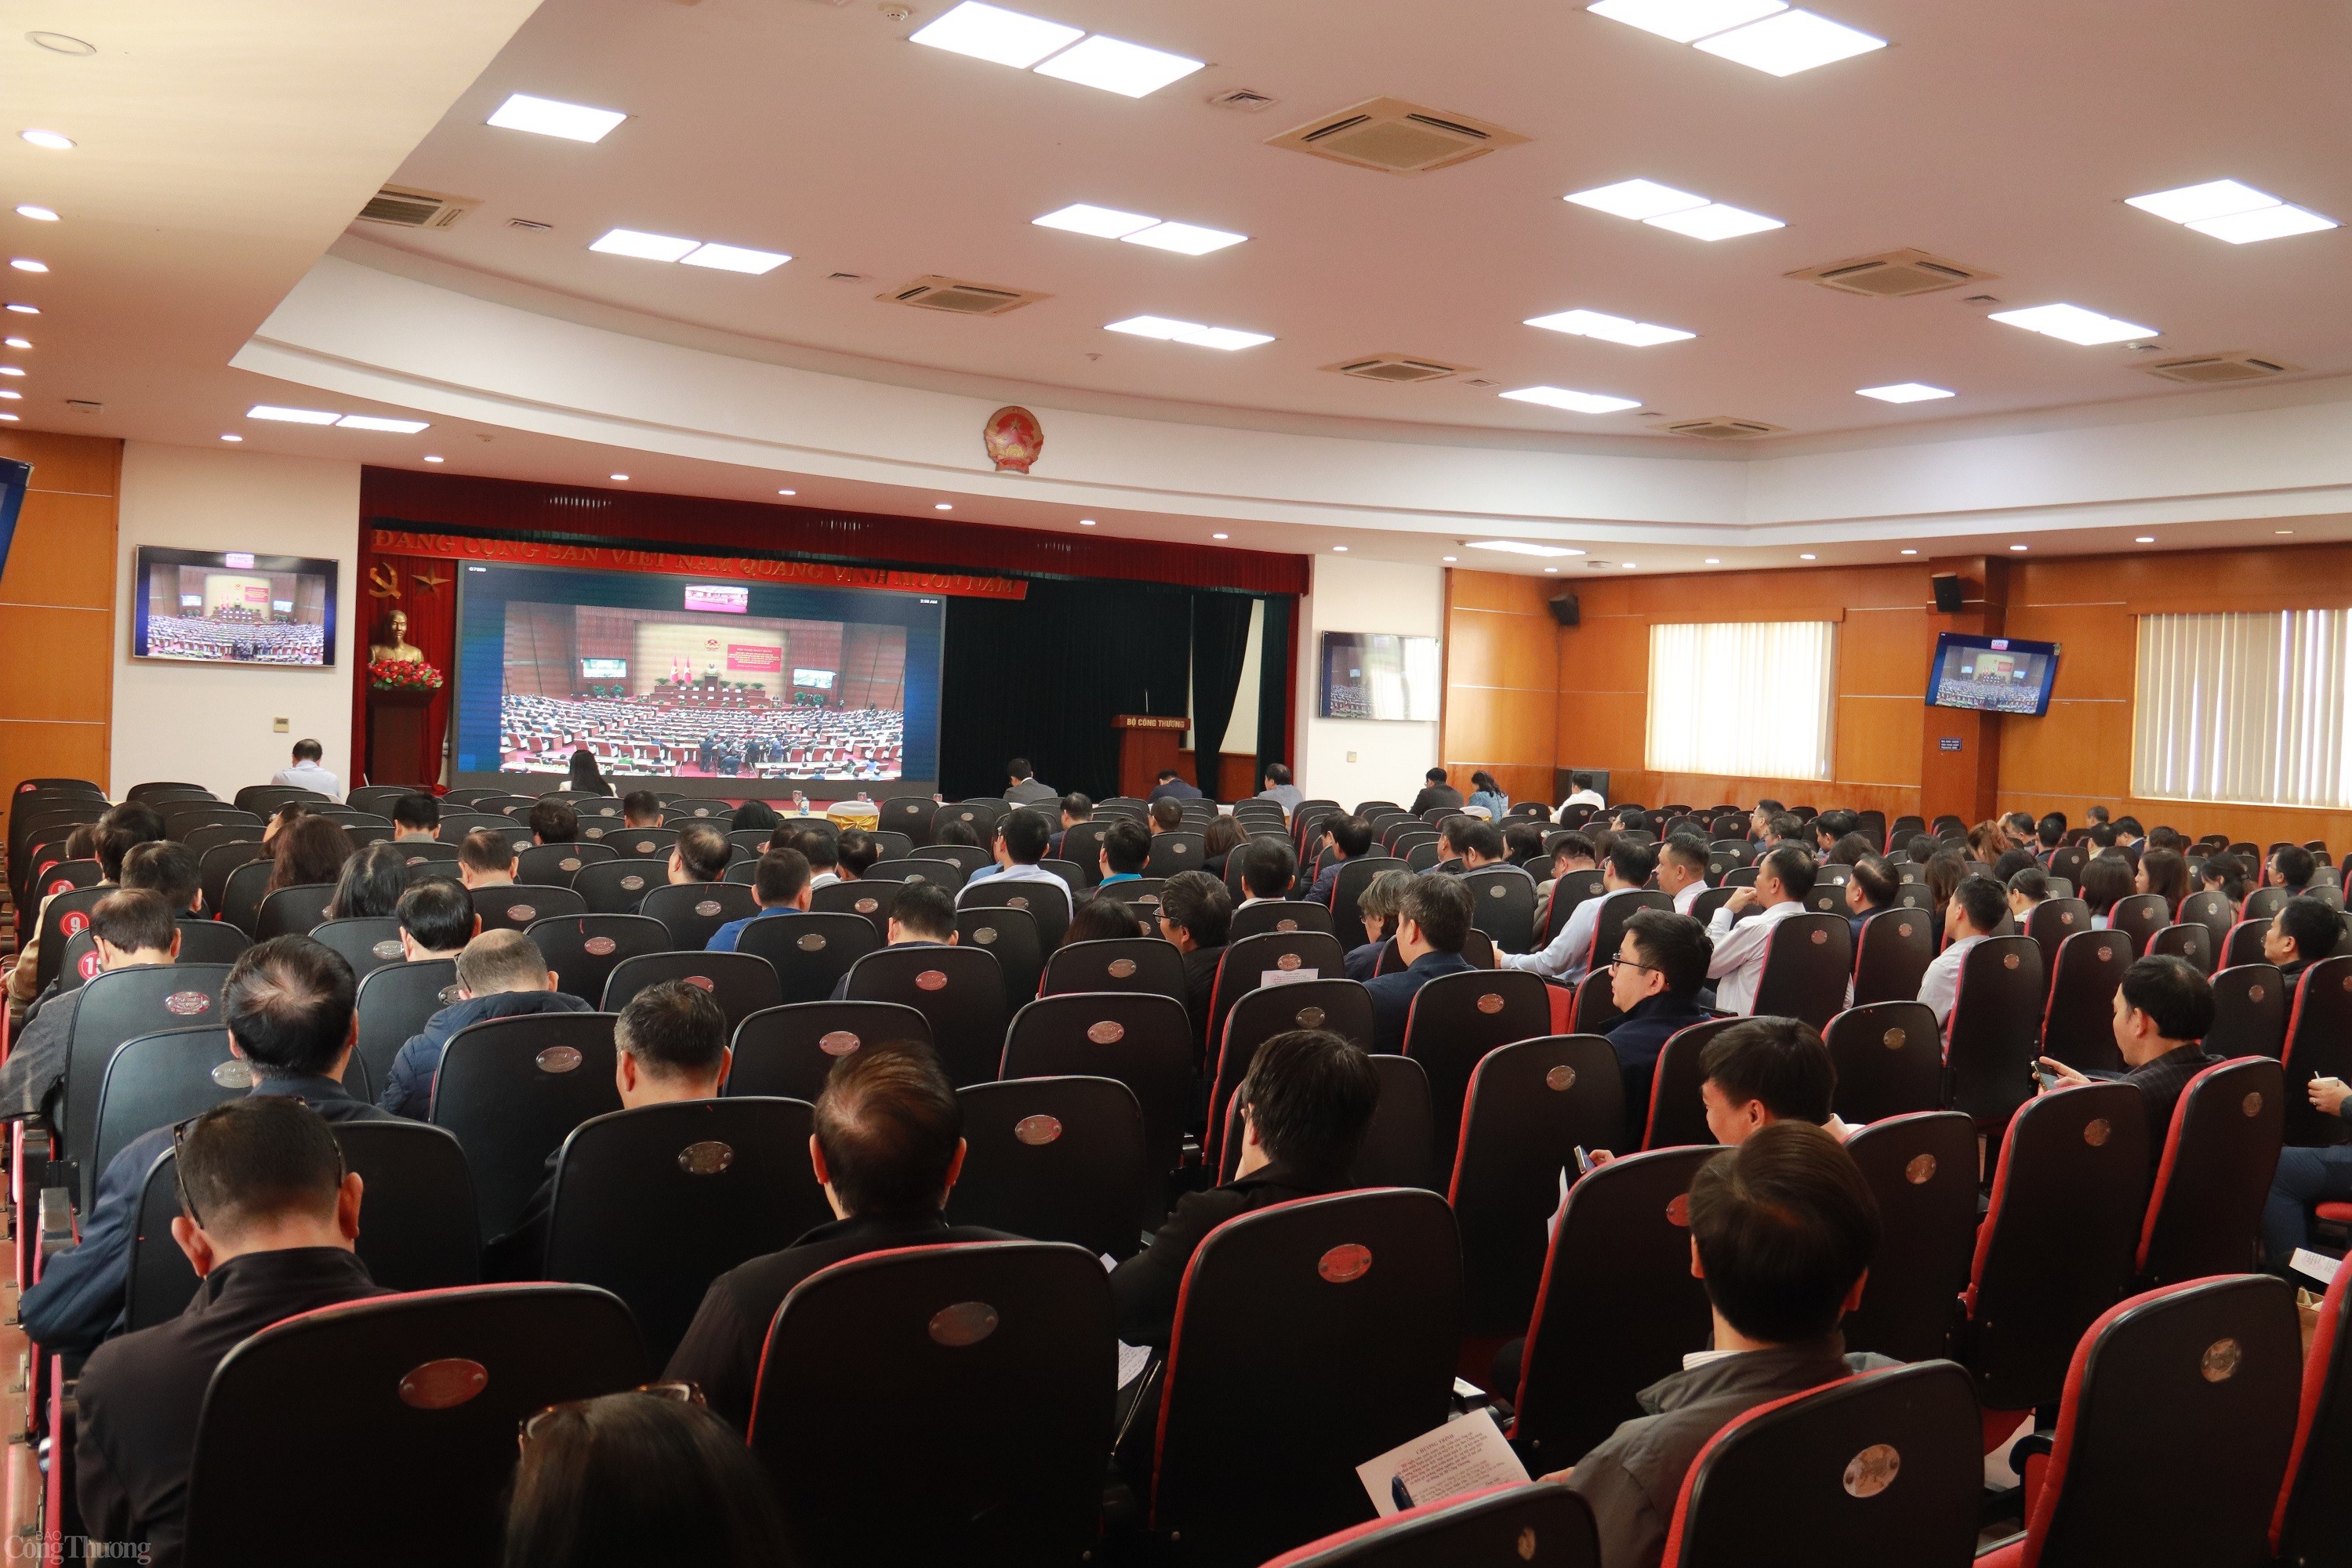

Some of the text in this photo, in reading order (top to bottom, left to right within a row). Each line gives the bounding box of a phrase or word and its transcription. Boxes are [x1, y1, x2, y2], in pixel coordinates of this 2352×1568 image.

[675, 555, 733, 573] NAM
[739, 559, 824, 579] QUANG
[1127, 717, 1185, 728] BỘ CÔNG THƯƠNG
[70, 916, 81, 933] 9
